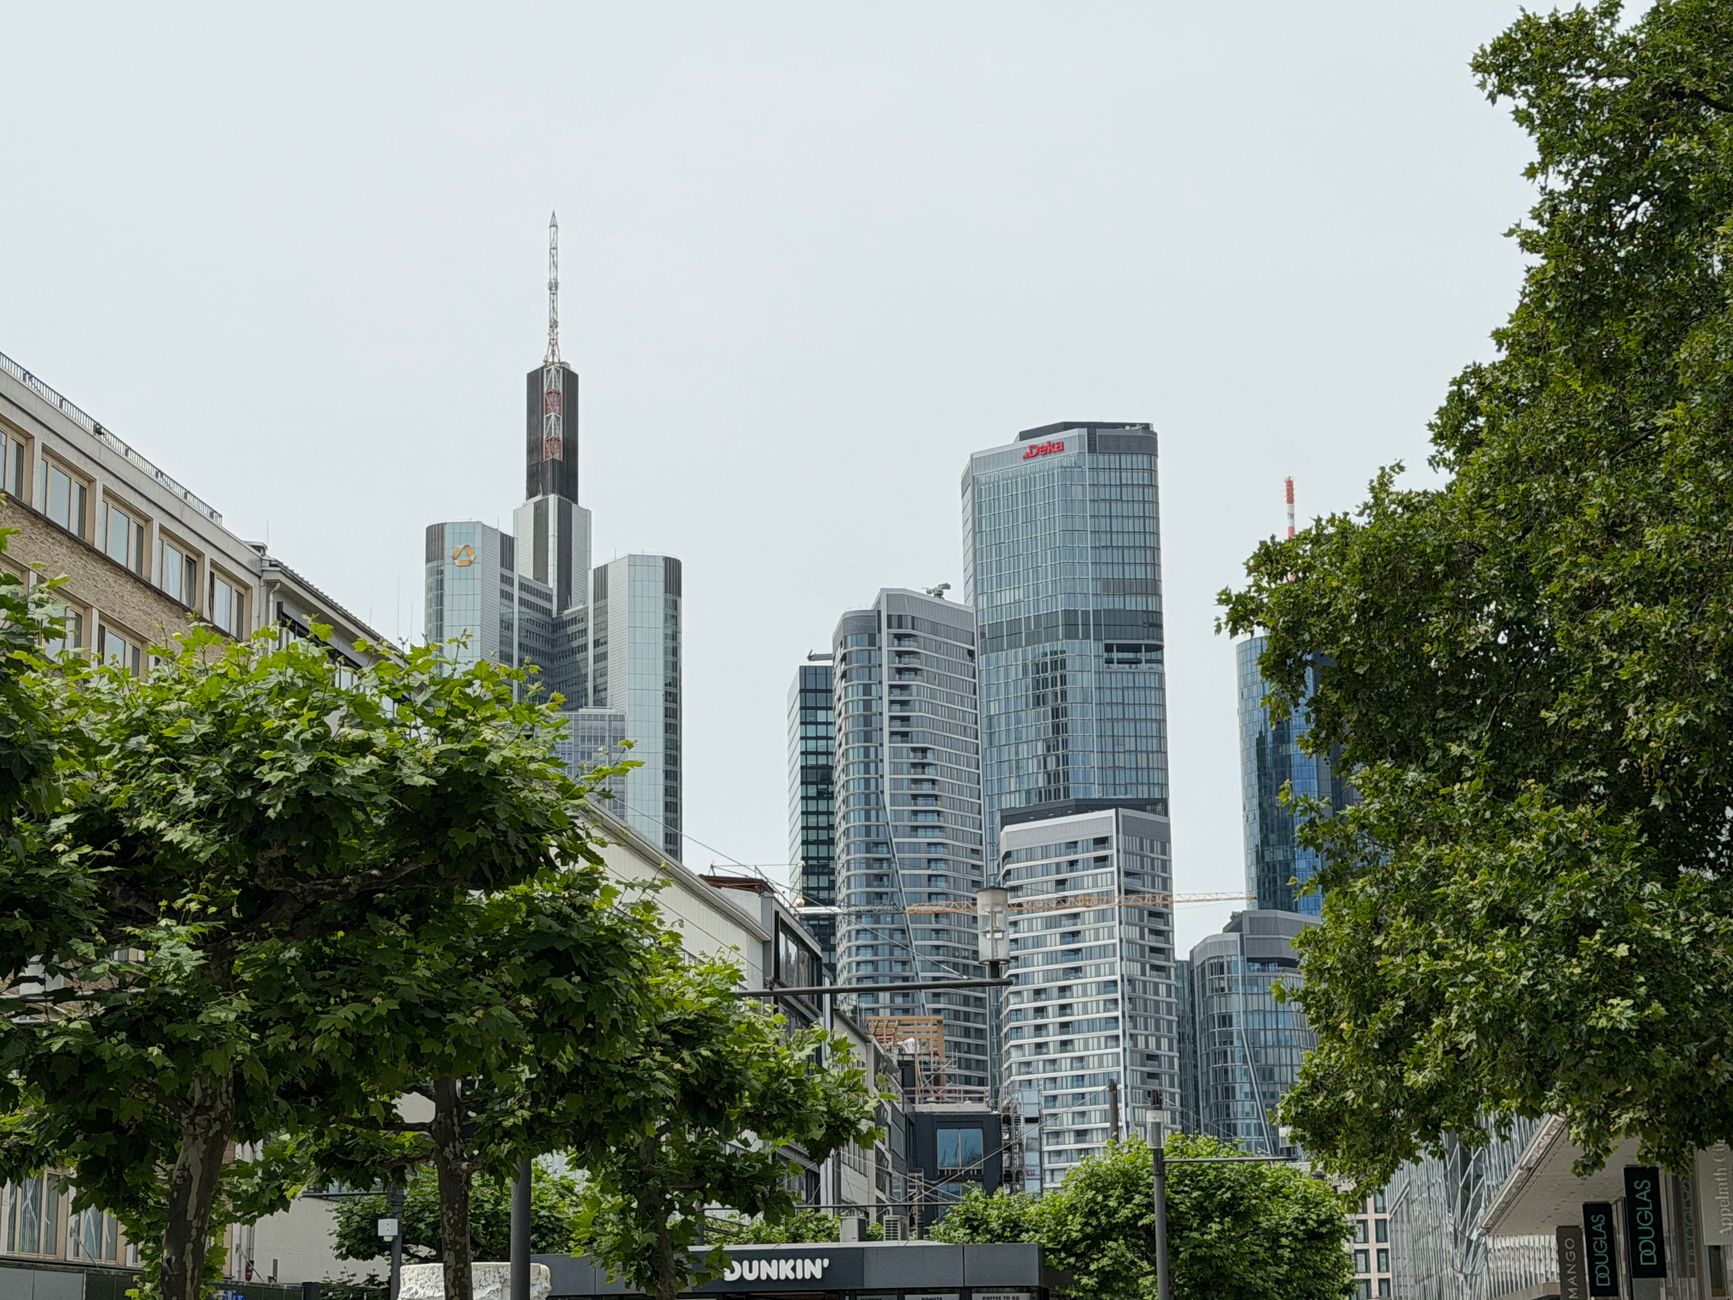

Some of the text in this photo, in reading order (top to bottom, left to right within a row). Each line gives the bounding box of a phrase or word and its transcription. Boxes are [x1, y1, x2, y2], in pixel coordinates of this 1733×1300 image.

[1029, 440, 1064, 457] Deka
[1591, 1214, 1610, 1286] DOUGLAS
[1634, 1180, 1657, 1265] DOUGLAS
[723, 1258, 829, 1281] DUNKIN'
[1564, 1238, 1579, 1299] MANGO
